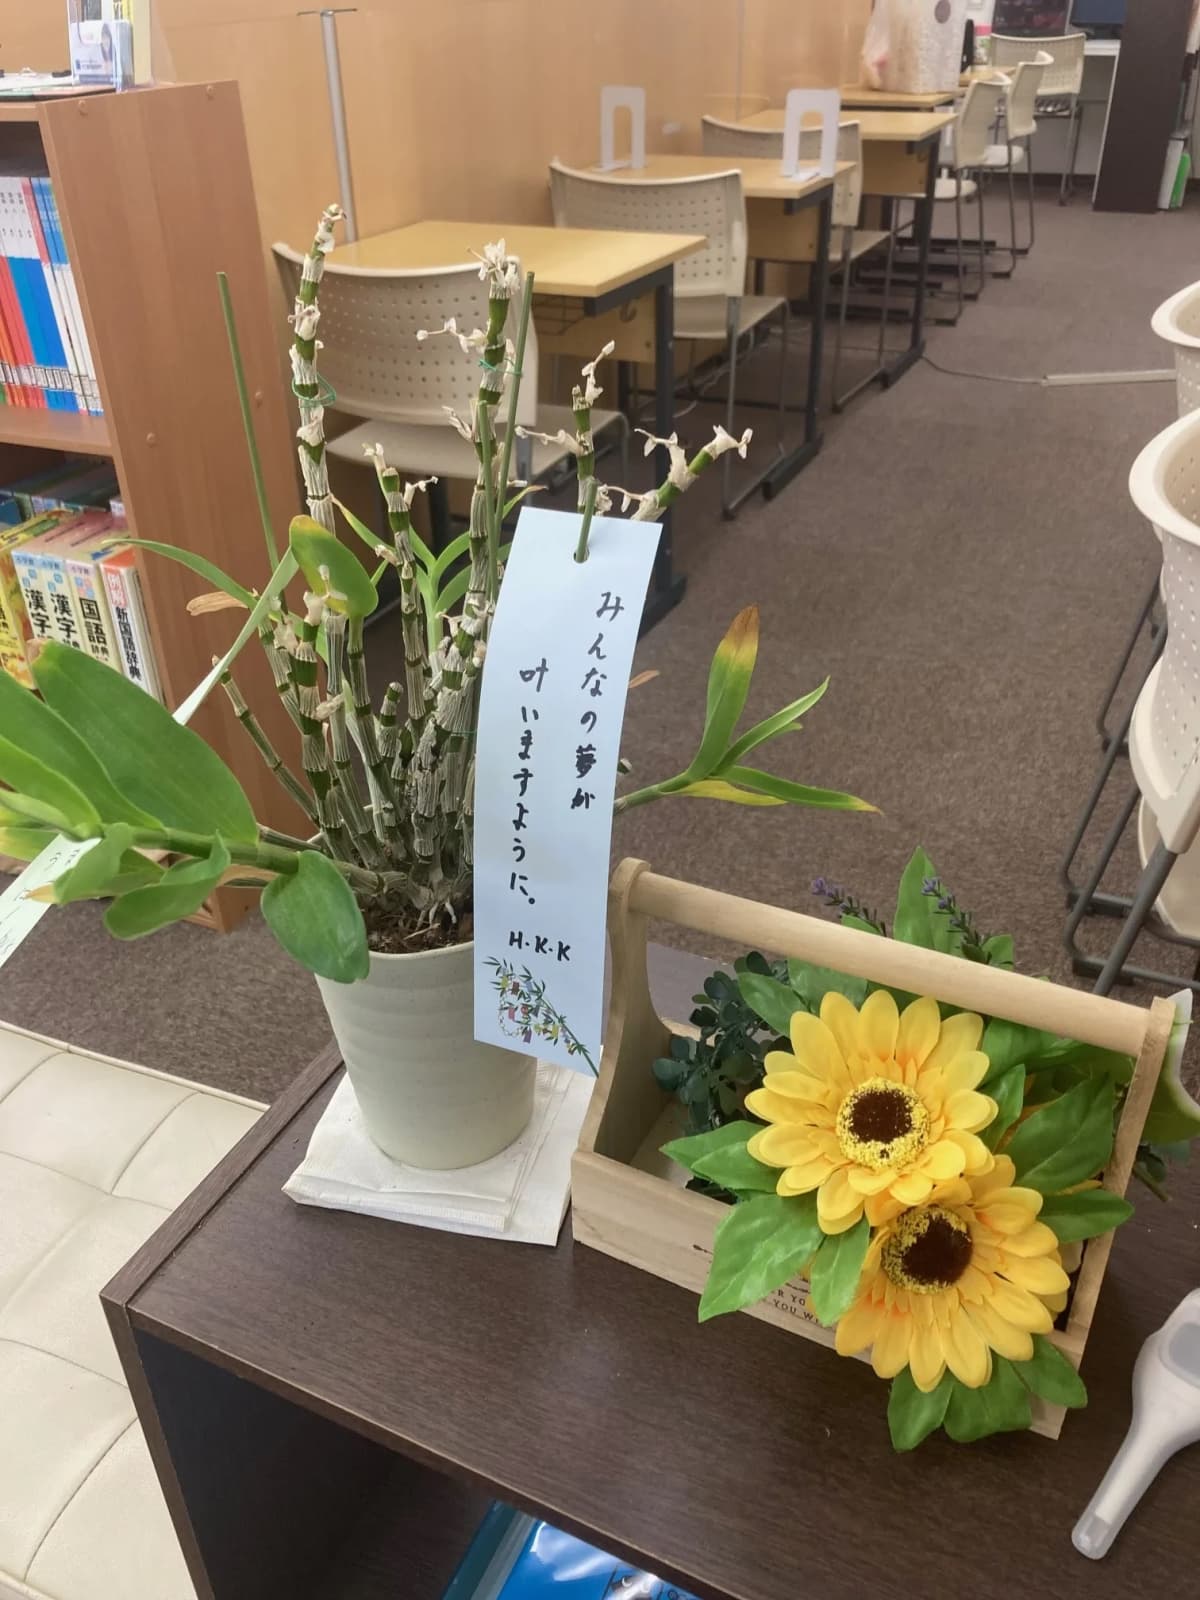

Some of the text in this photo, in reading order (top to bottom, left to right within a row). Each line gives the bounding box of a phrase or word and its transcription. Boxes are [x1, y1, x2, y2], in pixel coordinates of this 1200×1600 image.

[25, 588, 53, 638] 漢字
[570, 591, 625, 810] みんなの夢が
[509, 657, 549, 905] 叶いますように。
[773, 1299, 797, 1314] YOU
[791, 1294, 806, 1306] YO
